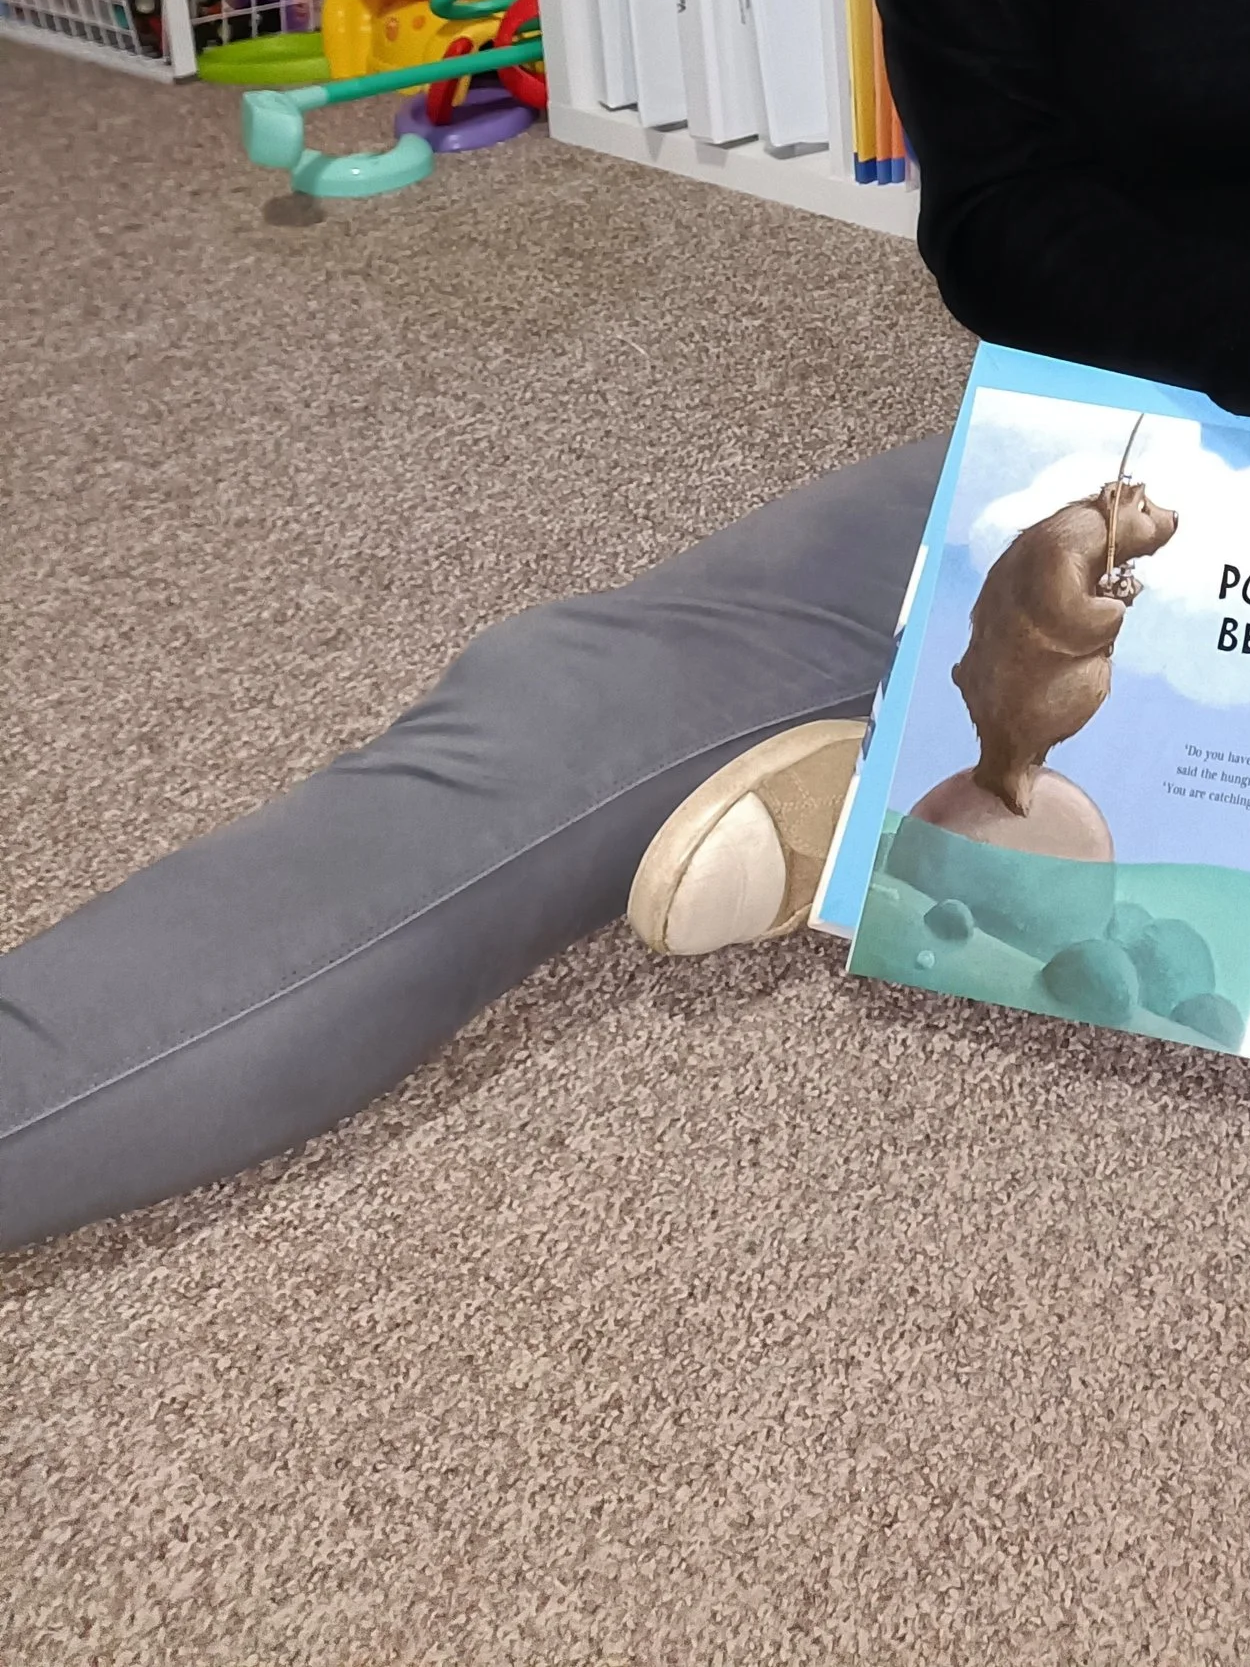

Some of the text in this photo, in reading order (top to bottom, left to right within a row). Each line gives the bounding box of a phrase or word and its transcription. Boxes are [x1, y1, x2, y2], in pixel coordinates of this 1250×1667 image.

[1204, 750, 1224, 762] you
[1176, 765, 1197, 777] said
[1201, 767, 1218, 781] the
[1189, 789, 1206, 800] are
